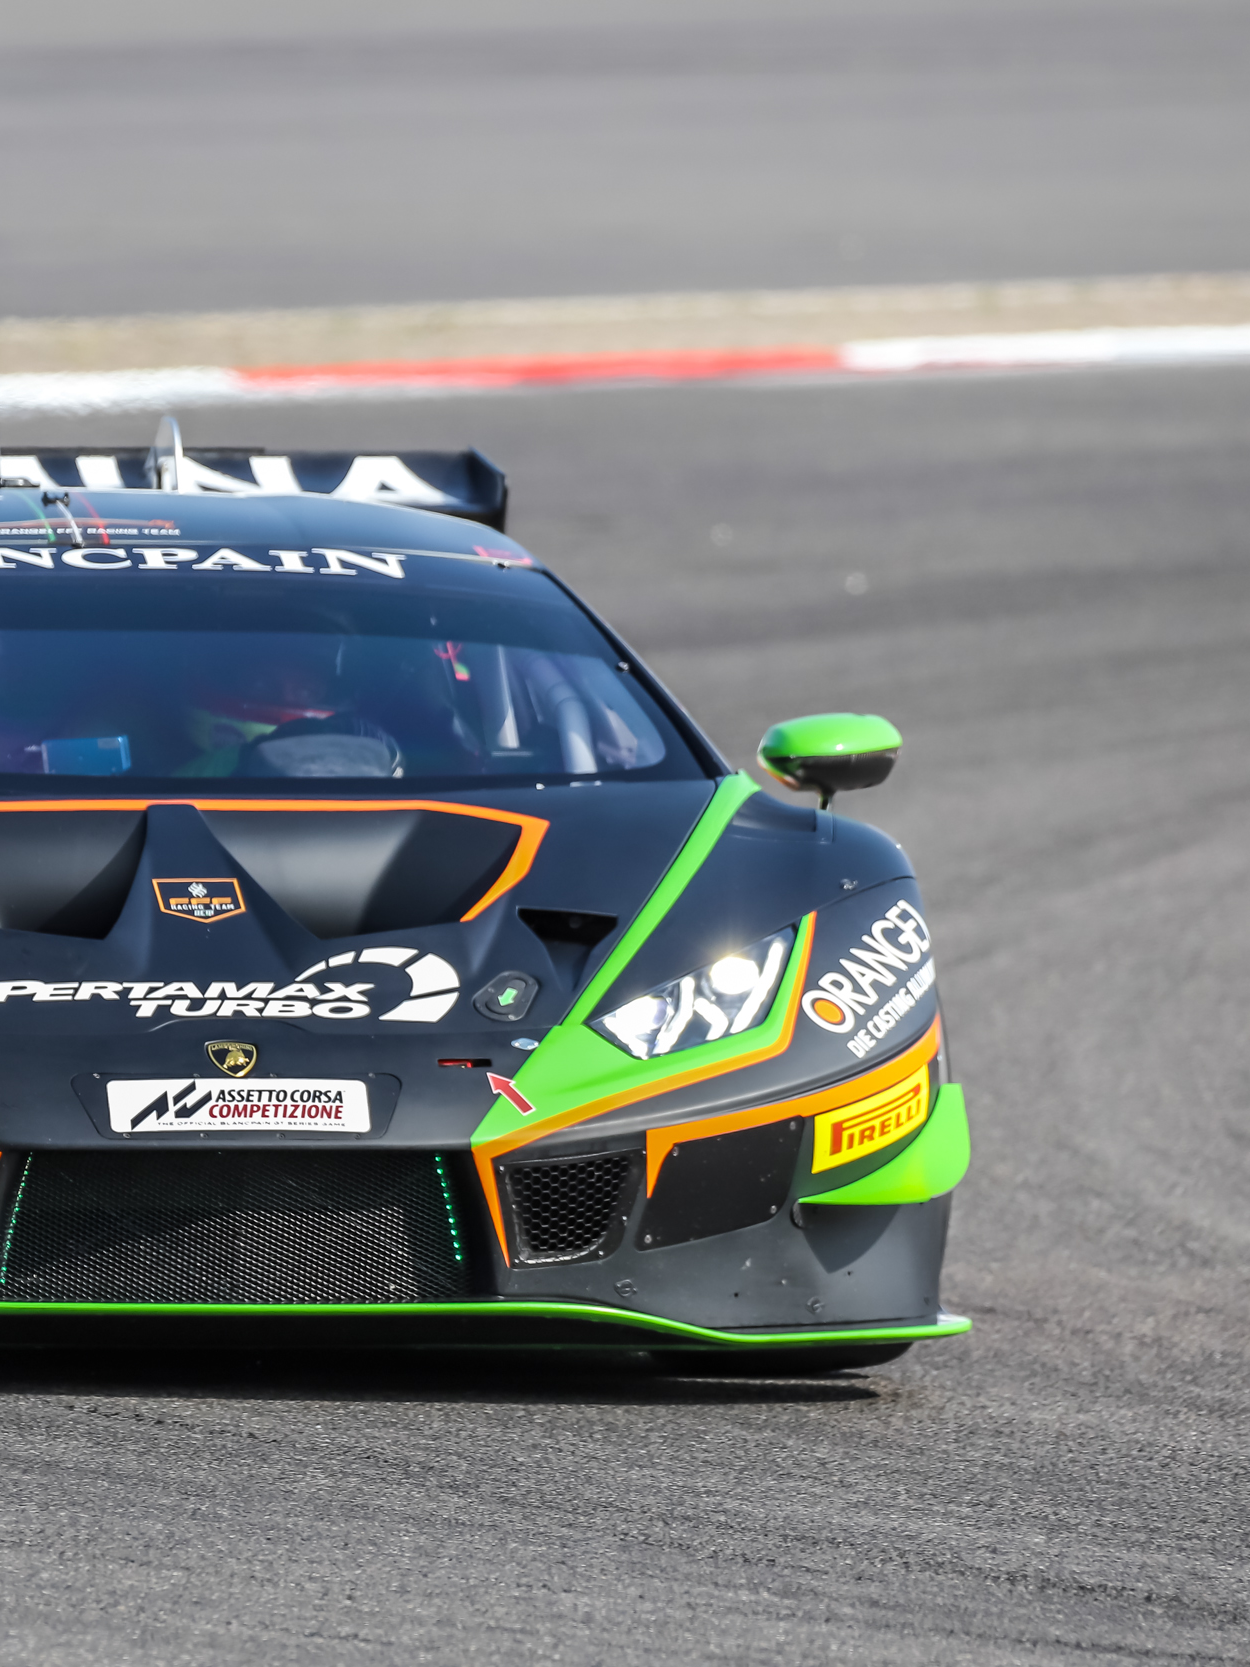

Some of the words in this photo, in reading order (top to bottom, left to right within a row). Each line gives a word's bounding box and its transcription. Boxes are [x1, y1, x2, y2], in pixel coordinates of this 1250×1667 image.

[170, 903, 204, 911] RACING
[209, 903, 235, 911] TEAM
[128, 997, 371, 1019] TURBO
[846, 1028, 878, 1059] DIE
[215, 1089, 288, 1104] ASSETTO
[289, 1089, 344, 1104] CORSA
[208, 1103, 344, 1120] COMPETIZIONE
[829, 1082, 922, 1157] PIRELLI
